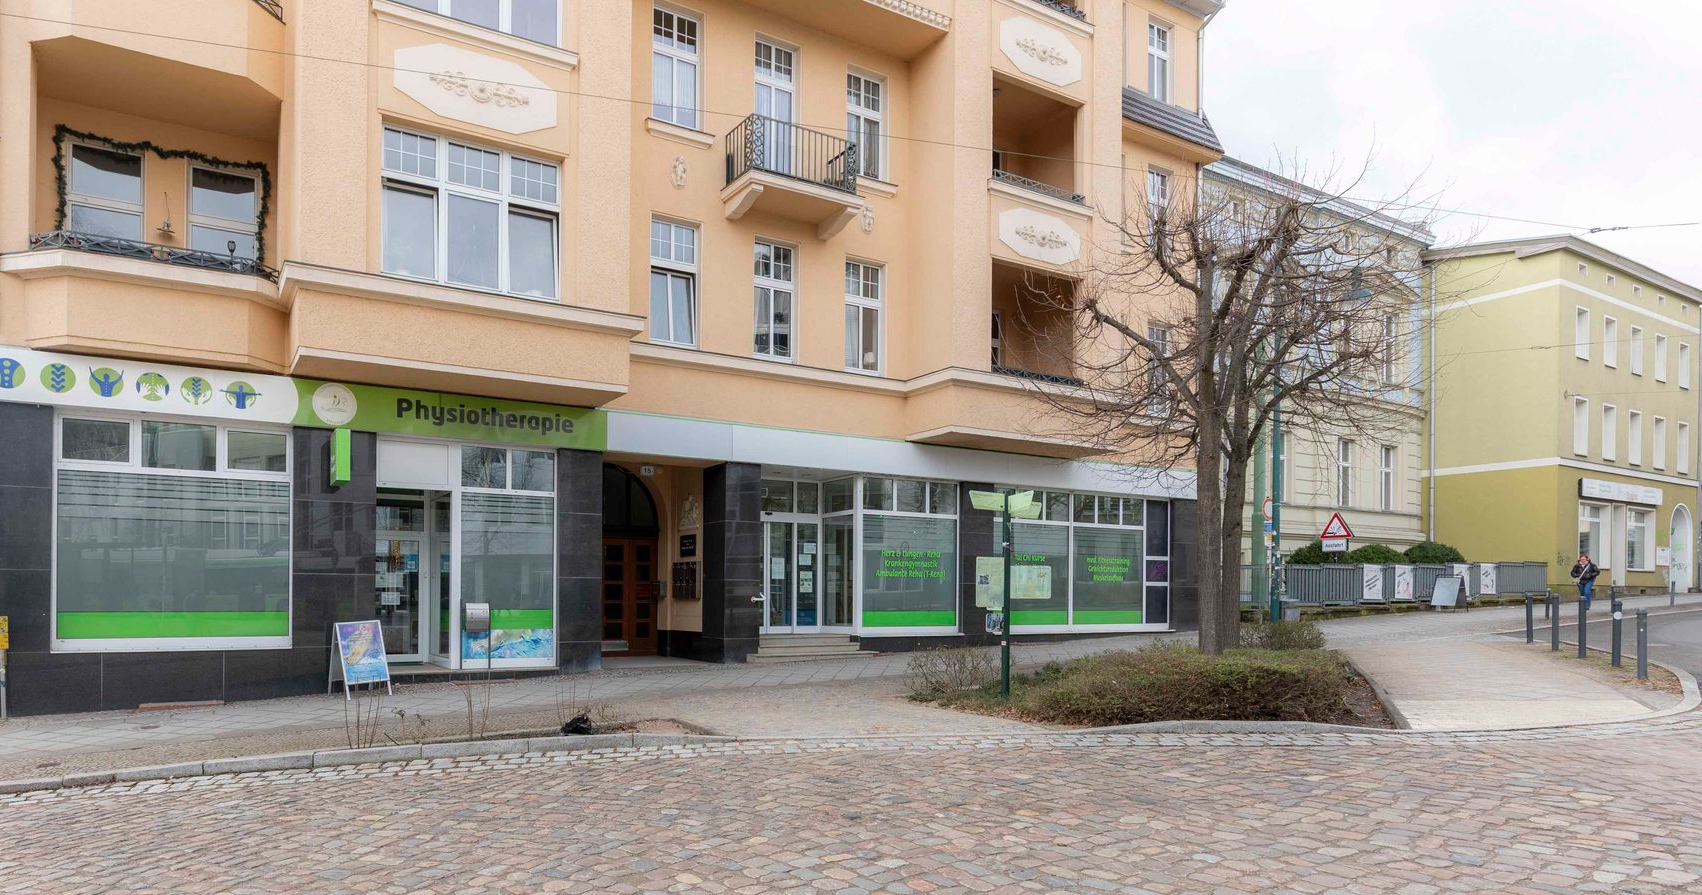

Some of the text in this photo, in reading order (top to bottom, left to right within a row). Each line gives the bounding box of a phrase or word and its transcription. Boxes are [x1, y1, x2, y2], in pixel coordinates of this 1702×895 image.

[396, 397, 575, 436] Physiotherapie
[881, 550, 895, 558] Herz
[902, 551, 923, 559] Lungen
[927, 550, 941, 558] Reha
[1014, 553, 1046, 562] Tai Chi Kurse
[884, 560, 938, 569] Krankengymnastik
[875, 569, 907, 577] Ambulante
[908, 569, 923, 578] Reha
